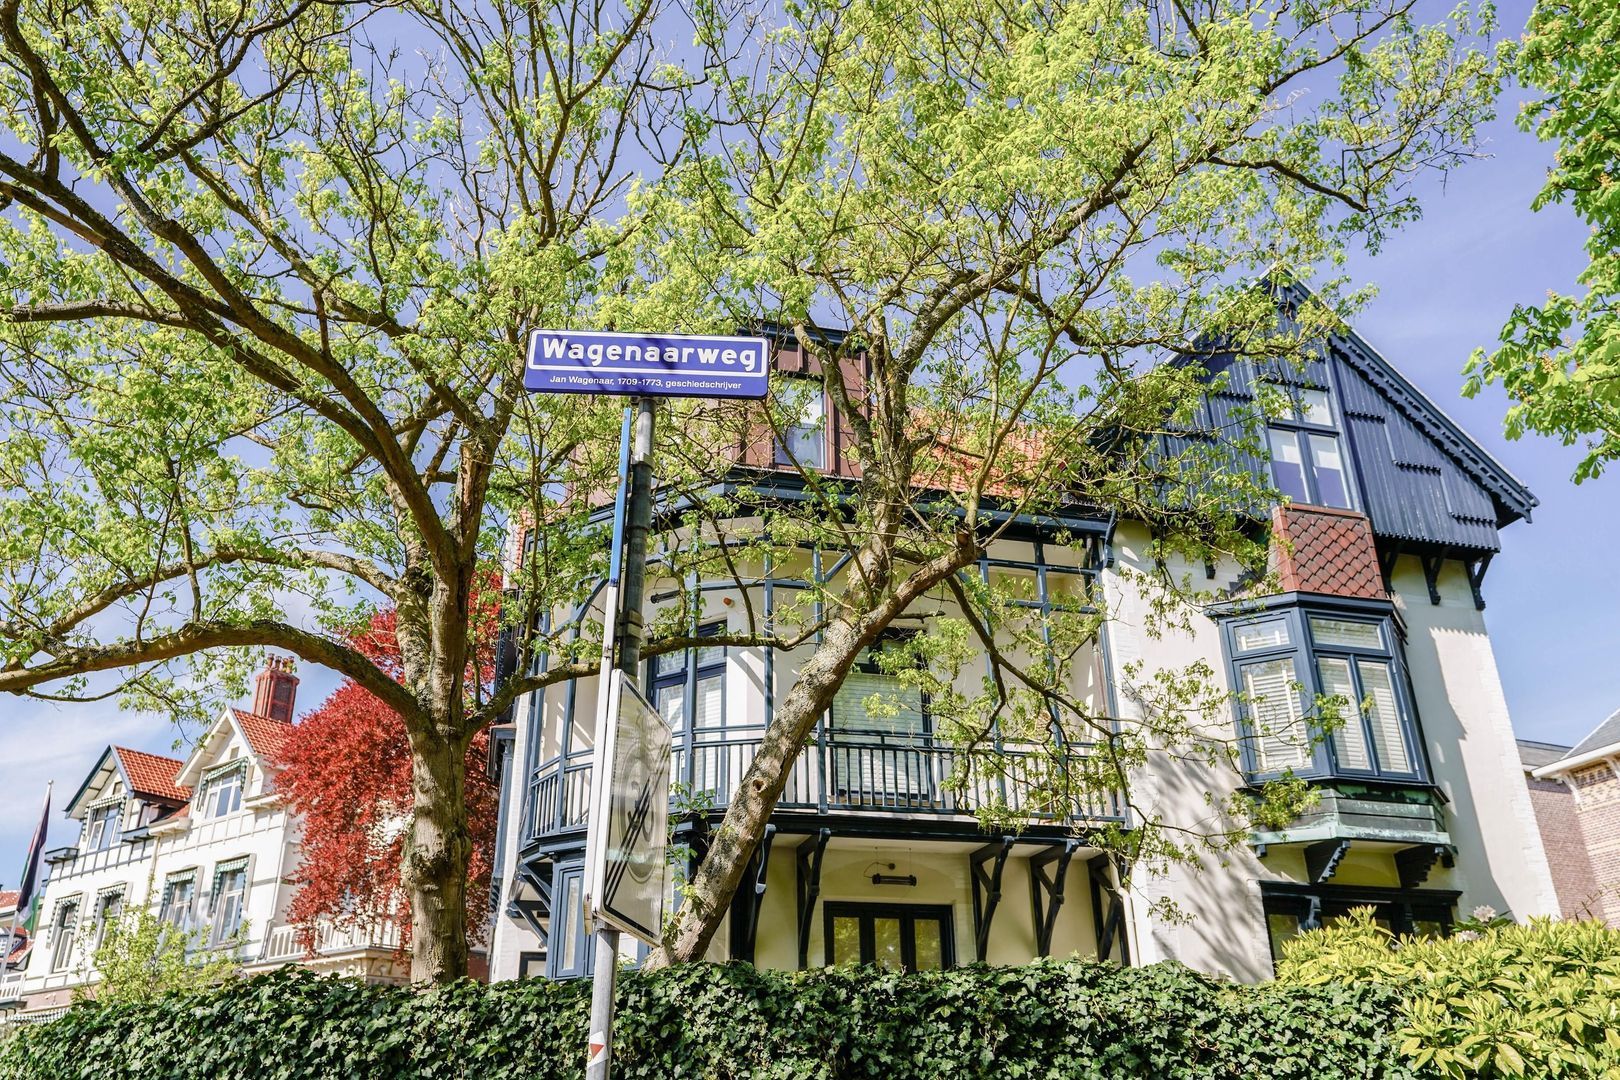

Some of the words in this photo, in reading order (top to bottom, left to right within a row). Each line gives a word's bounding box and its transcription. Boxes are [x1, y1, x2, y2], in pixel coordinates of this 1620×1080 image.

[542, 337, 756, 372] Wagenaarweg
[549, 375, 567, 384] Jan
[568, 376, 615, 386] Wagenaar,
[617, 378, 664, 388] 1709-1773,
[665, 380, 742, 391] geschiedschrijver
